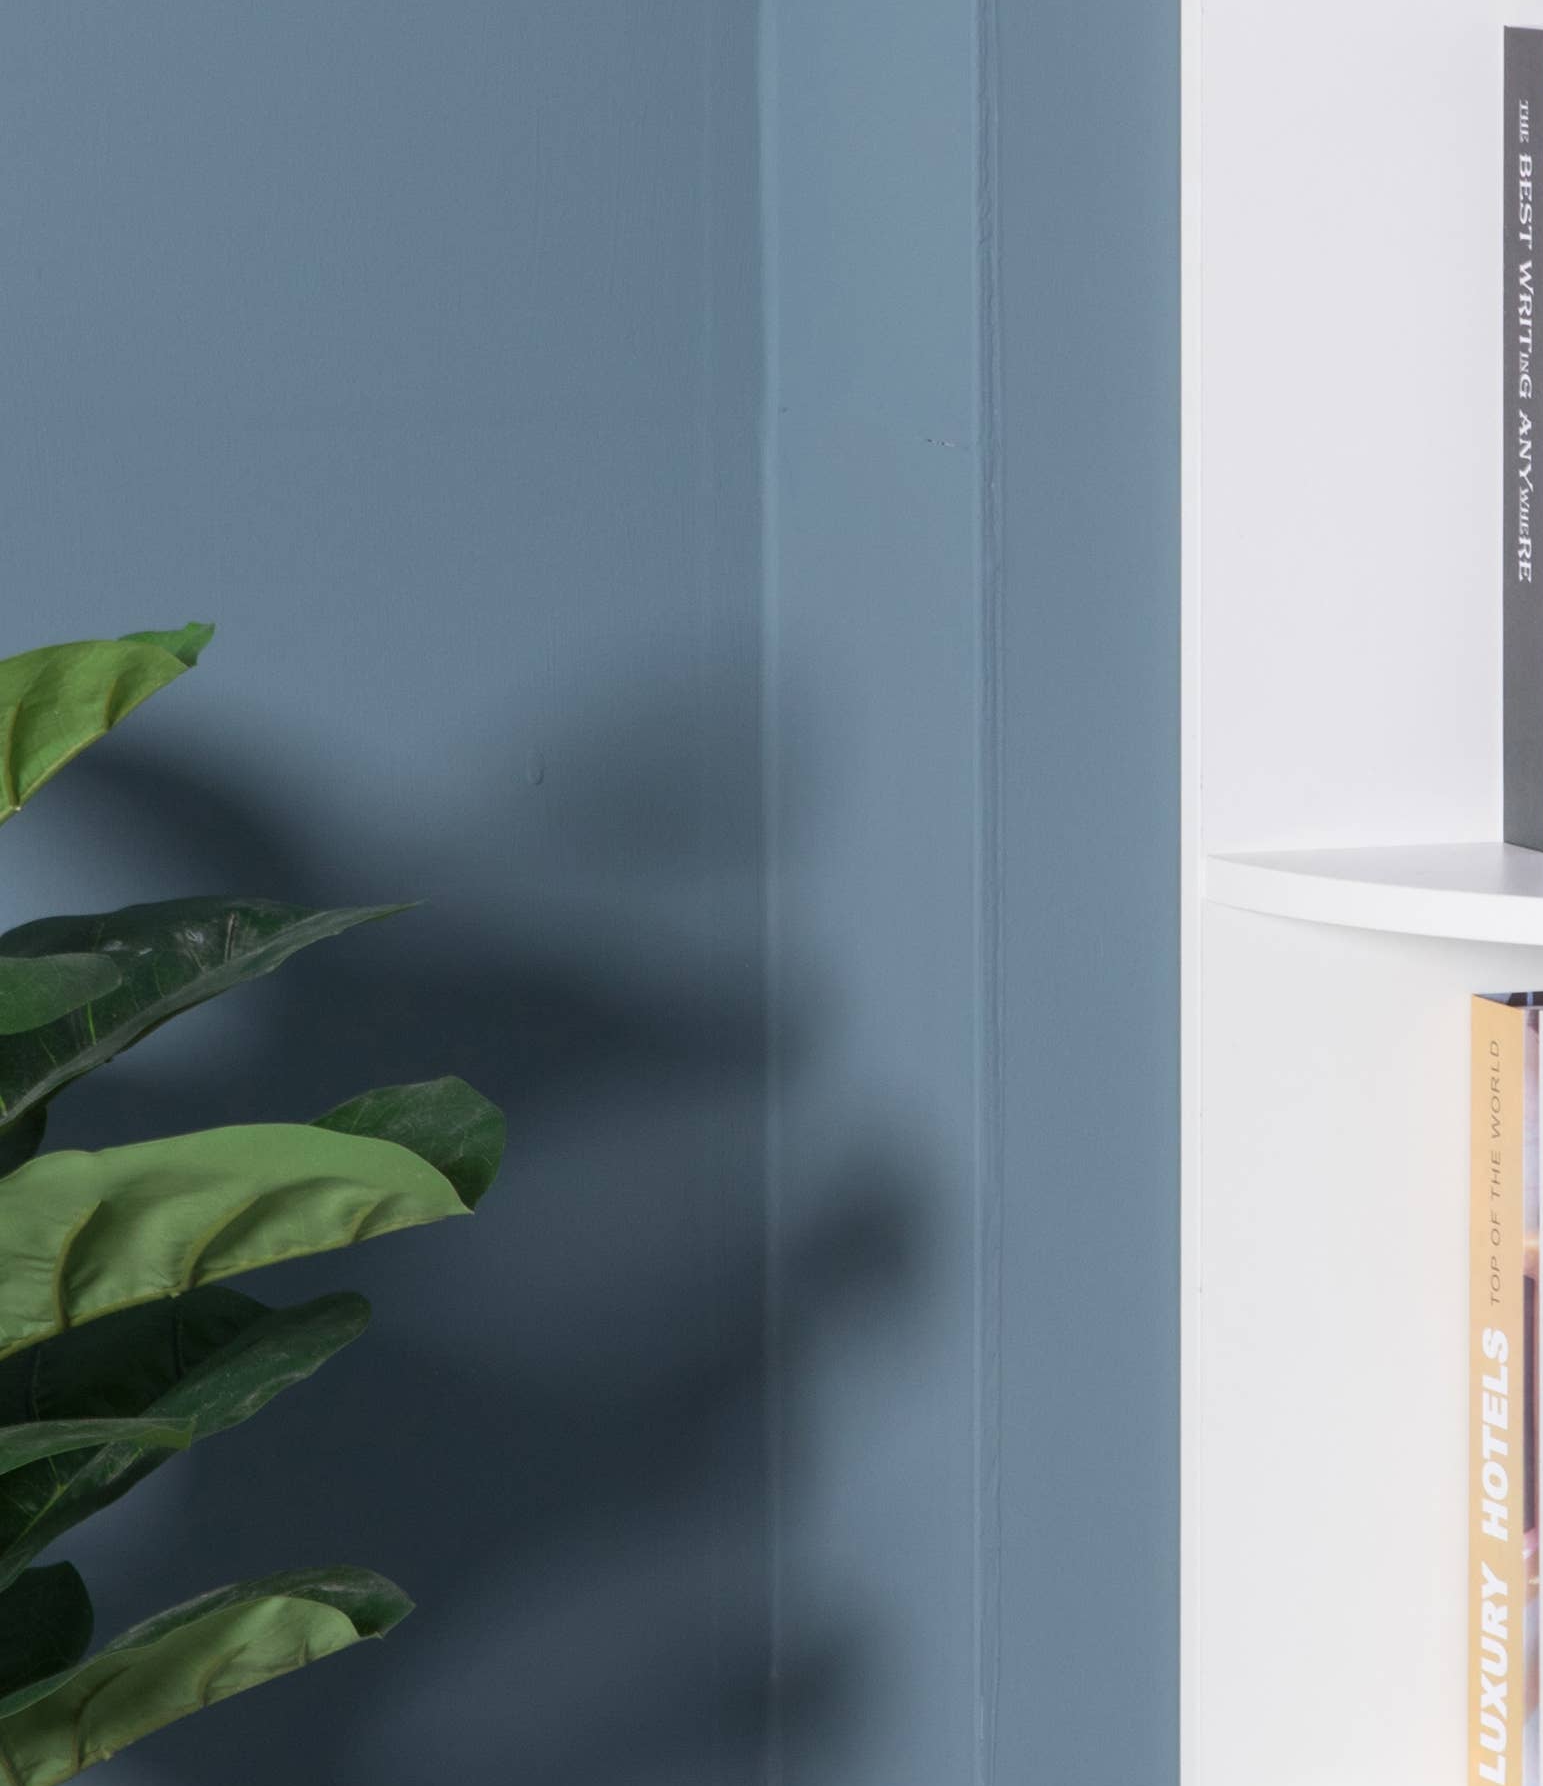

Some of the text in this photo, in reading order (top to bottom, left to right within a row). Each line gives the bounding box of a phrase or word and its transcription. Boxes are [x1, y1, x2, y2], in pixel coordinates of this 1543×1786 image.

[1518, 98, 1535, 583] THE BEST WRITING ANYWHERE
[1489, 1038, 1501, 1307] TOP OF THE WORLD
[1478, 1327, 1509, 1786] LUXURY HOTELS
